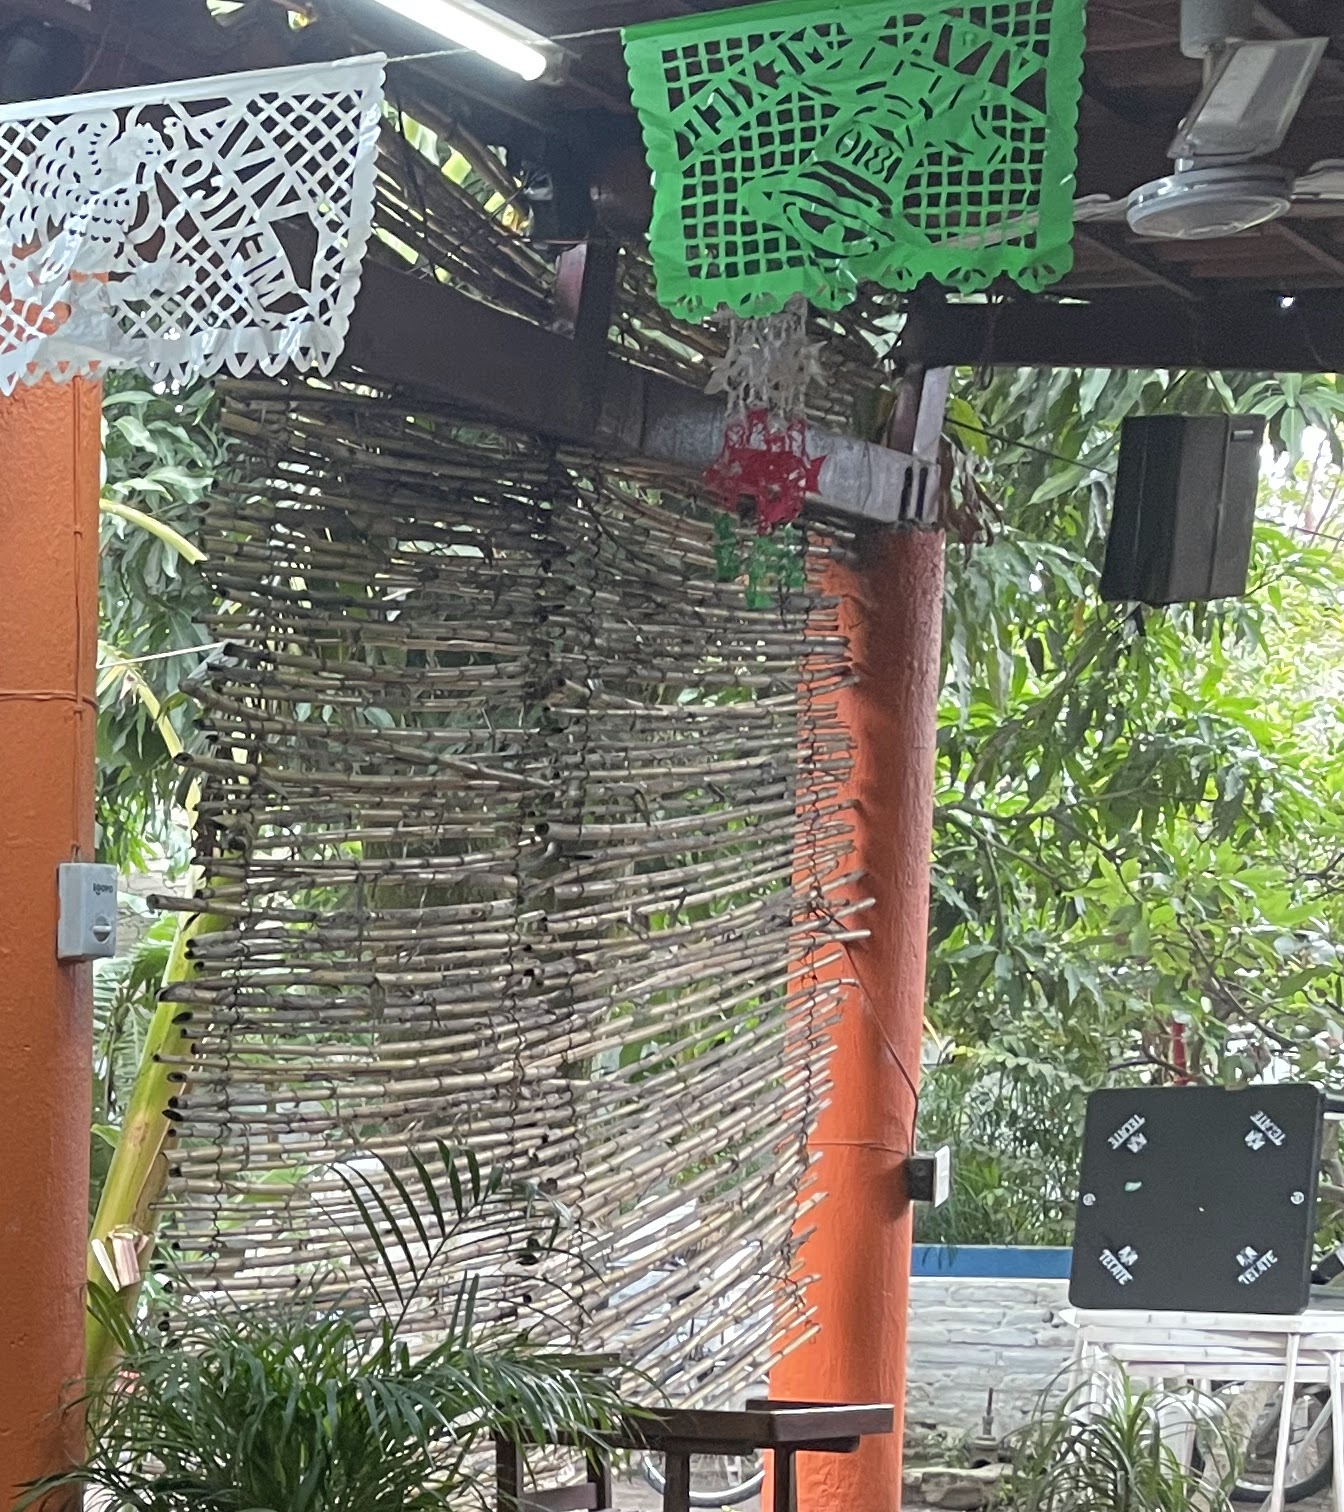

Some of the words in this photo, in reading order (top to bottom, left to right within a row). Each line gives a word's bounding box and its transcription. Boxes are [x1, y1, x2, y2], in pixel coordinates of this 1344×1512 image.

[1107, 1114, 1146, 1150] TECATE
[1249, 1110, 1287, 1146] TECATE
[1099, 1249, 1134, 1286] TECATE
[1237, 1250, 1279, 1285] TECATE
